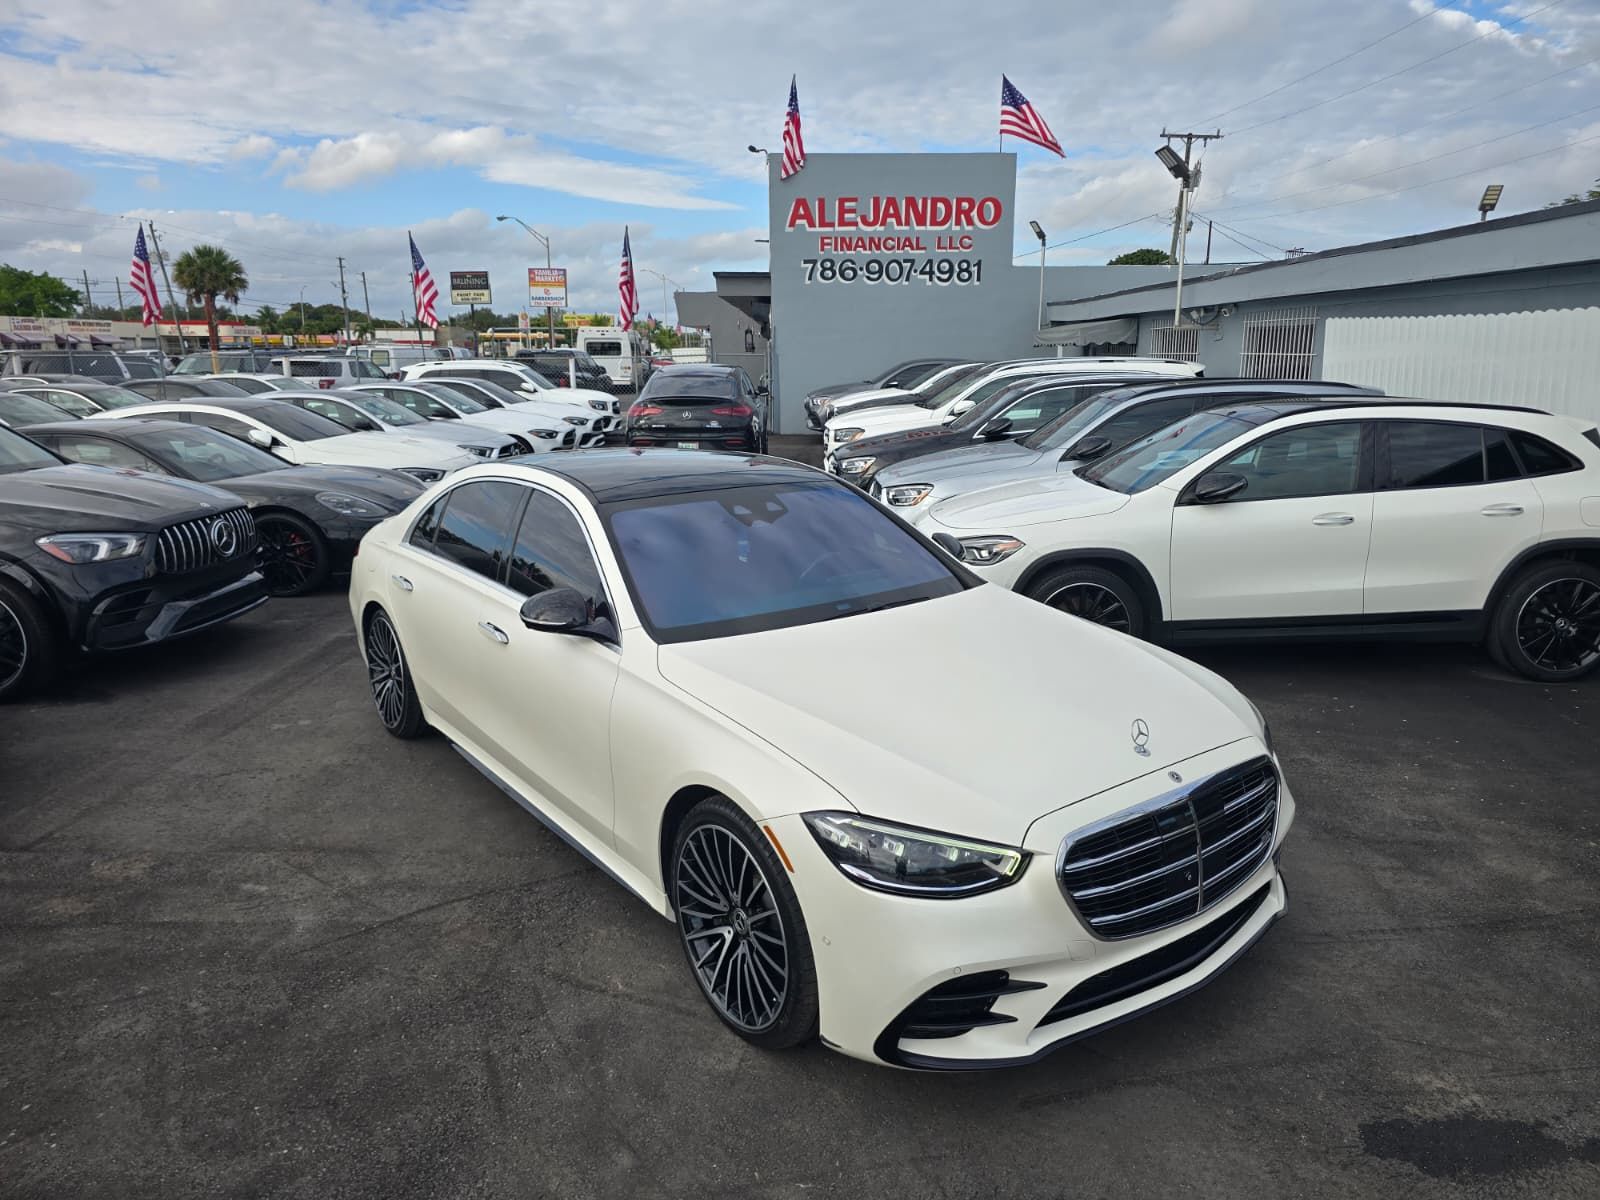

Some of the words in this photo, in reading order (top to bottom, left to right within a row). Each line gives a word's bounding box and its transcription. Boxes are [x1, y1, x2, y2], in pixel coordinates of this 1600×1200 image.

[785, 196, 1003, 232] ALEJANDRO
[819, 235, 927, 254] FINANCIAL
[936, 234, 973, 253] LLC
